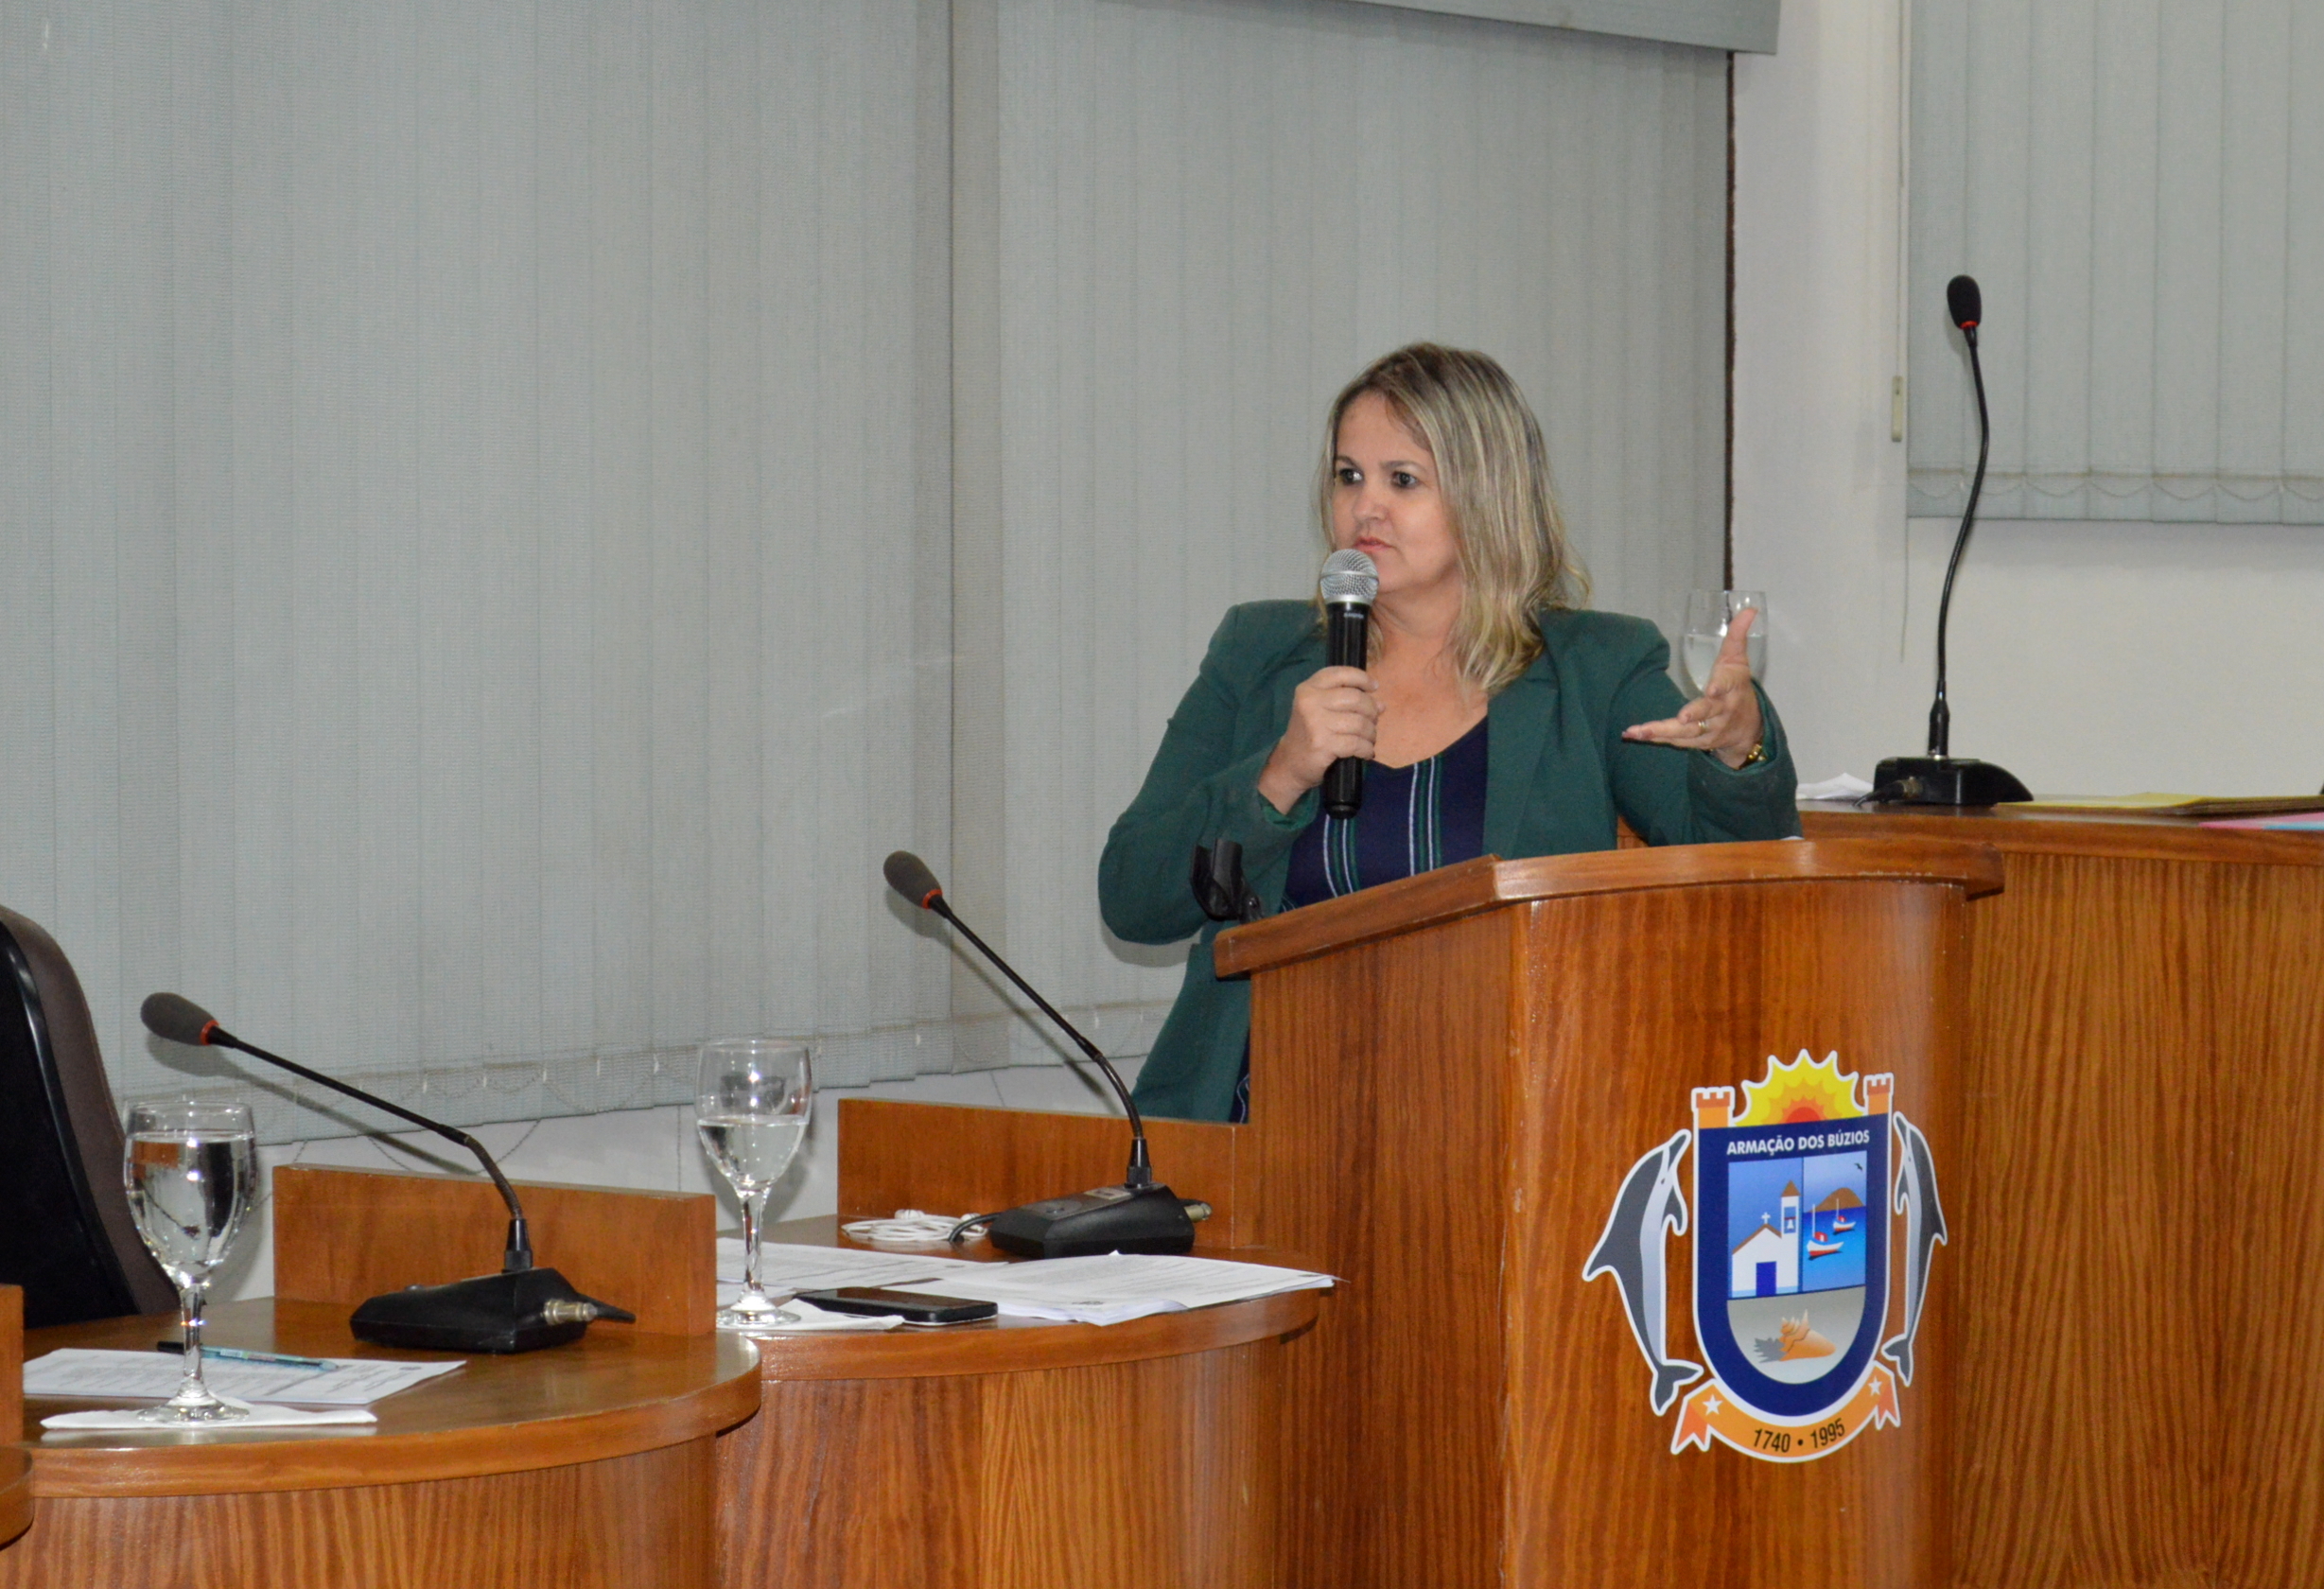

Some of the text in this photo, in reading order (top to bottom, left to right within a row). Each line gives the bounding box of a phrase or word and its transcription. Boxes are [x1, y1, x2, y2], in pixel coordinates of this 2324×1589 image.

[1726, 1129, 1870, 1156] ARMAÇÃO DOS BÚZIOS
[1754, 1418, 1845, 1453] 1740 1995
